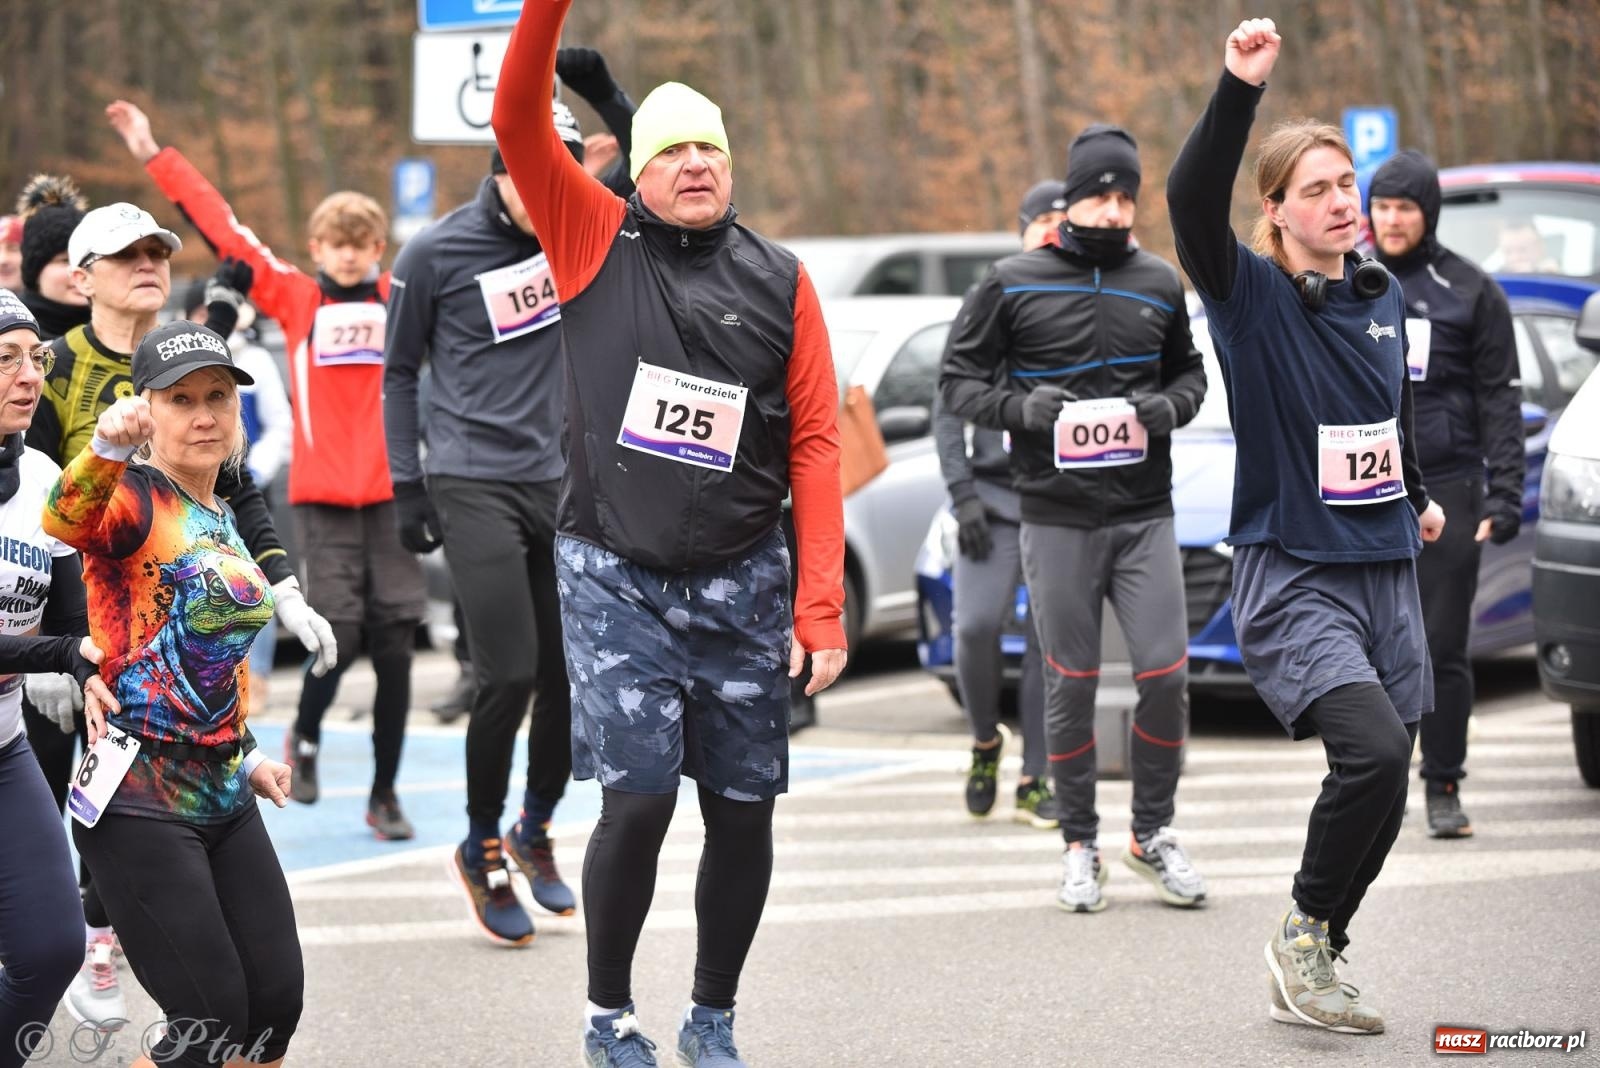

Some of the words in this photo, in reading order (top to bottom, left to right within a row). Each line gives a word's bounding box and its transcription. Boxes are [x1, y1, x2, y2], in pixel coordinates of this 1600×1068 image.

[1354, 113, 1386, 161] P
[508, 278, 556, 314] 164
[333, 324, 373, 345] 227
[675, 378, 737, 400] Twardziela
[655, 398, 715, 441] 125
[1073, 421, 1130, 446] 004
[1330, 429, 1355, 438] BIEG
[1346, 449, 1392, 481] 124
